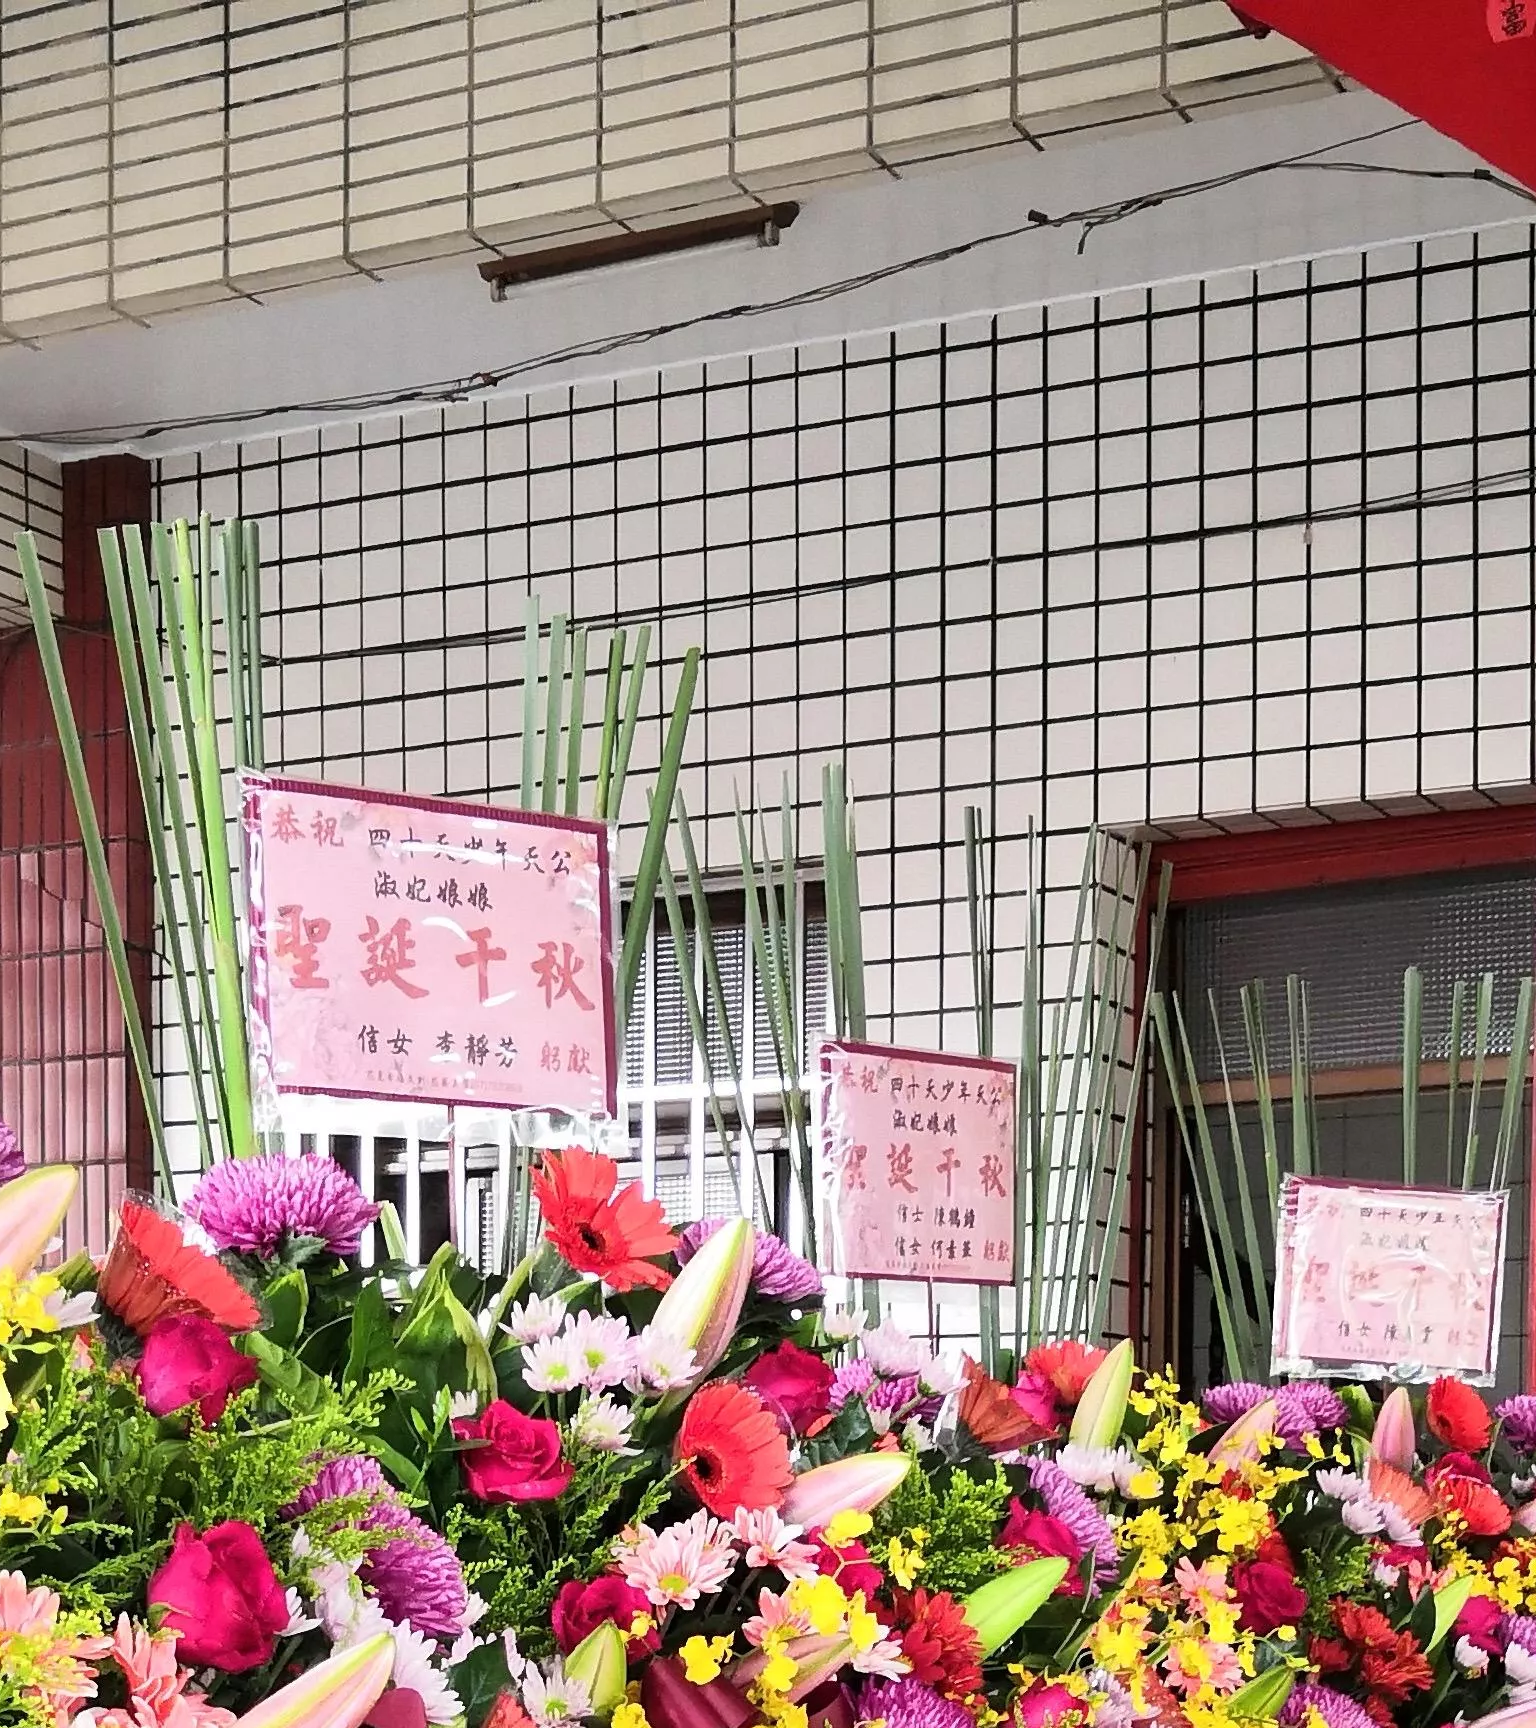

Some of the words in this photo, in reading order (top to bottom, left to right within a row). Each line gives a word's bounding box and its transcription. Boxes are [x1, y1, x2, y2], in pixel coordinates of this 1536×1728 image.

[271, 803, 344, 850] 恭祝
[274, 904, 596, 1012] 聖誕千秋
[357, 1023, 413, 1056] 信女
